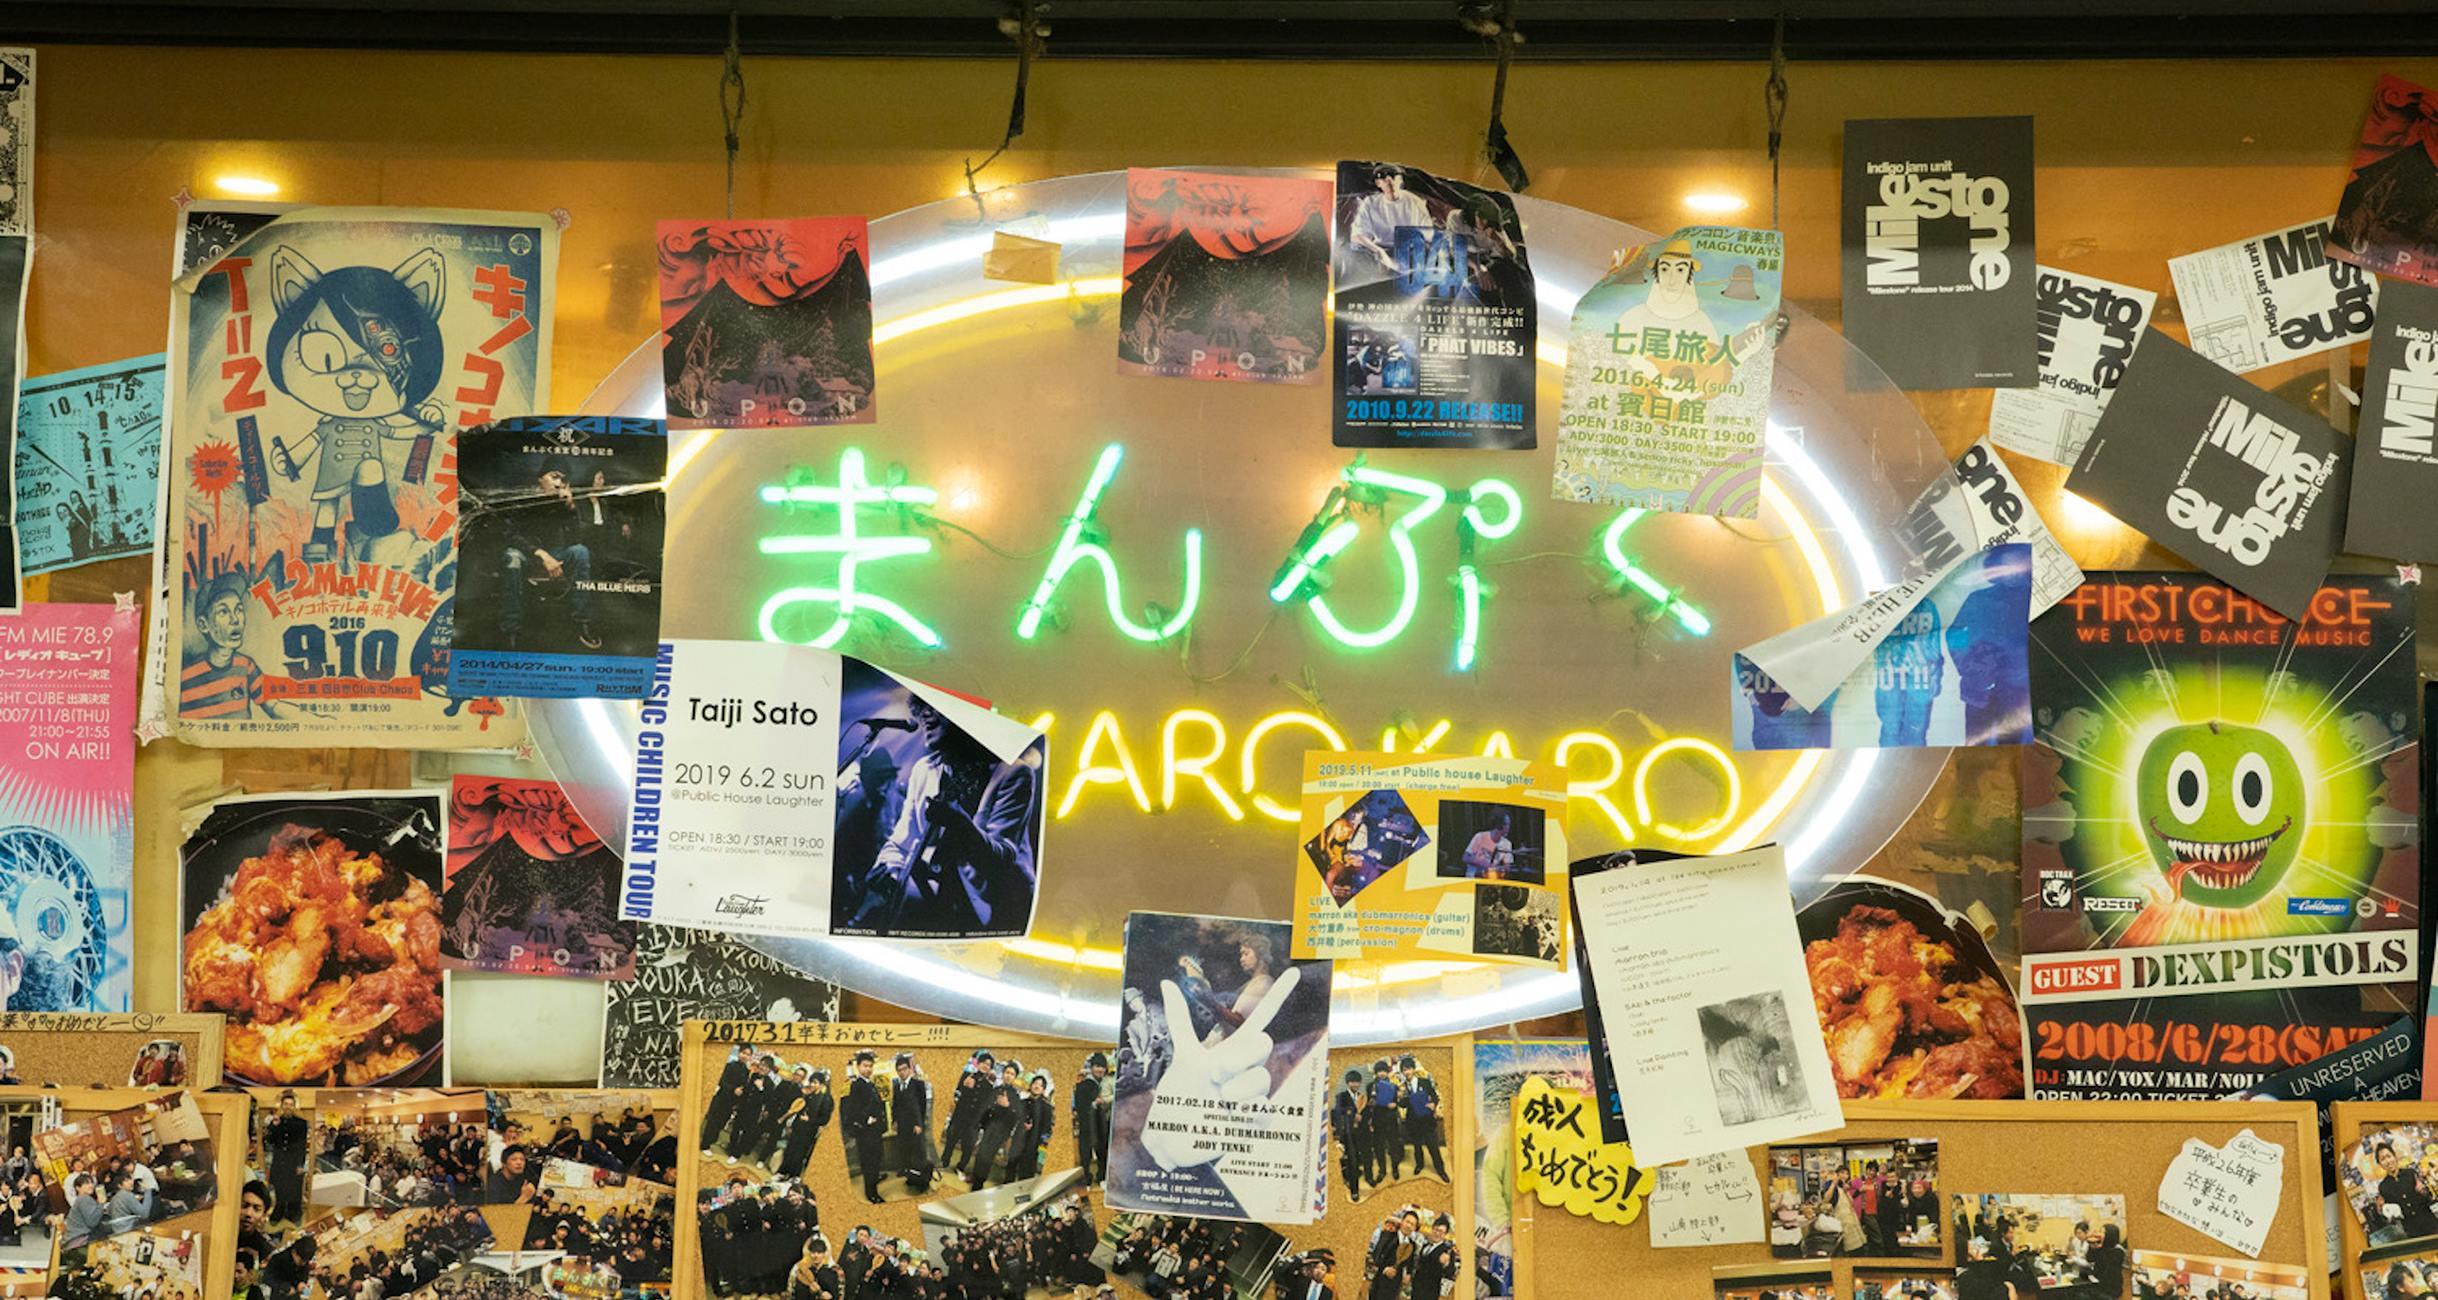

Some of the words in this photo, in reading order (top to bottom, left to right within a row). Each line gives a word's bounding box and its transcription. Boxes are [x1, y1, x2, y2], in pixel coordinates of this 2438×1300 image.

[1867, 162, 1904, 176] indigo
[1905, 161, 1928, 175] jam
[1930, 160, 1953, 174] unit
[1695, 239, 1782, 258] MAGICWAYS
[1605, 322, 1742, 369] 七尾旅人
[1590, 365, 1698, 395] 2016.4.24
[1702, 379, 1746, 398] (sun)
[1346, 399, 1435, 420] 2010.9.22
[1438, 401, 1524, 423] RELEASE!!
[1587, 394, 1610, 411] at
[1615, 391, 1708, 425] 賓日館
[557, 427, 576, 444] 祝
[1565, 414, 1607, 430] OPEN
[1611, 418, 1654, 435] 18:30
[1660, 423, 1709, 440] START
[1713, 429, 1756, 445] 19:00
[1569, 430, 1629, 447] ADV:3000
[1634, 436, 1694, 453] DAY:3500
[758, 441, 1714, 672] まんぷく
[381, 566, 441, 623] LIVE
[576, 581, 597, 592] THA
[597, 581, 623, 593] BLUE
[623, 582, 652, 595] HERB
[2059, 584, 2183, 624] FIRST
[330, 616, 366, 630] 2016
[31, 627, 67, 644] MIE
[73, 626, 114, 645] 78.9
[2076, 628, 2111, 643] WE
[2126, 628, 2186, 644] LOVE
[2200, 628, 2280, 645] DANCE
[2296, 629, 2372, 646] MUSIC
[282, 623, 400, 682] 9.10
[459, 659, 544, 672] 2014/04/27
[639, 643, 675, 726] MUSIC
[25, 691, 65, 705] CUBE
[689, 697, 743, 728] Taiji
[752, 699, 819, 727] Sato
[26, 741, 60, 760] ON
[65, 741, 111, 760] AIR!!
[674, 763, 731, 788] 2019
[740, 766, 777, 790] 6.2
[783, 770, 825, 791] sun
[1318, 764, 1373, 777] 2019.5.11
[1402, 766, 1441, 780] Public
[1443, 768, 1482, 781] house
[1484, 770, 1536, 787] Laughter
[629, 729, 665, 855] CHILDREN
[671, 788, 722, 803] @Public
[723, 791, 763, 806] House
[766, 793, 825, 809] Laughter
[668, 830, 706, 844] OPEN
[709, 832, 742, 846] 18:30
[753, 834, 789, 848] START
[792, 836, 825, 850] 19:00
[623, 859, 658, 920] TOUR
[1309, 896, 1332, 906] LIVE
[1362, 924, 1424, 937] cro-magnon
[1425, 925, 1466, 938] (drums)
[1336, 937, 1399, 949] (percussion)
[2033, 964, 2118, 989] GUEST
[2131, 938, 2408, 989] DEXPISTOLS
[2289, 1033, 2412, 1097] UNRESERVED
[2354, 1076, 2368, 1092] A
[1155, 1094, 1216, 1110] 2017.02.18
[1521, 1092, 1586, 1140] 成人
[1147, 1120, 1190, 1134] MARRON
[1223, 1125, 1303, 1143] DUBMARRONICS
[1192, 1139, 1219, 1152] JODY
[1220, 1141, 1255, 1155] TENKU
